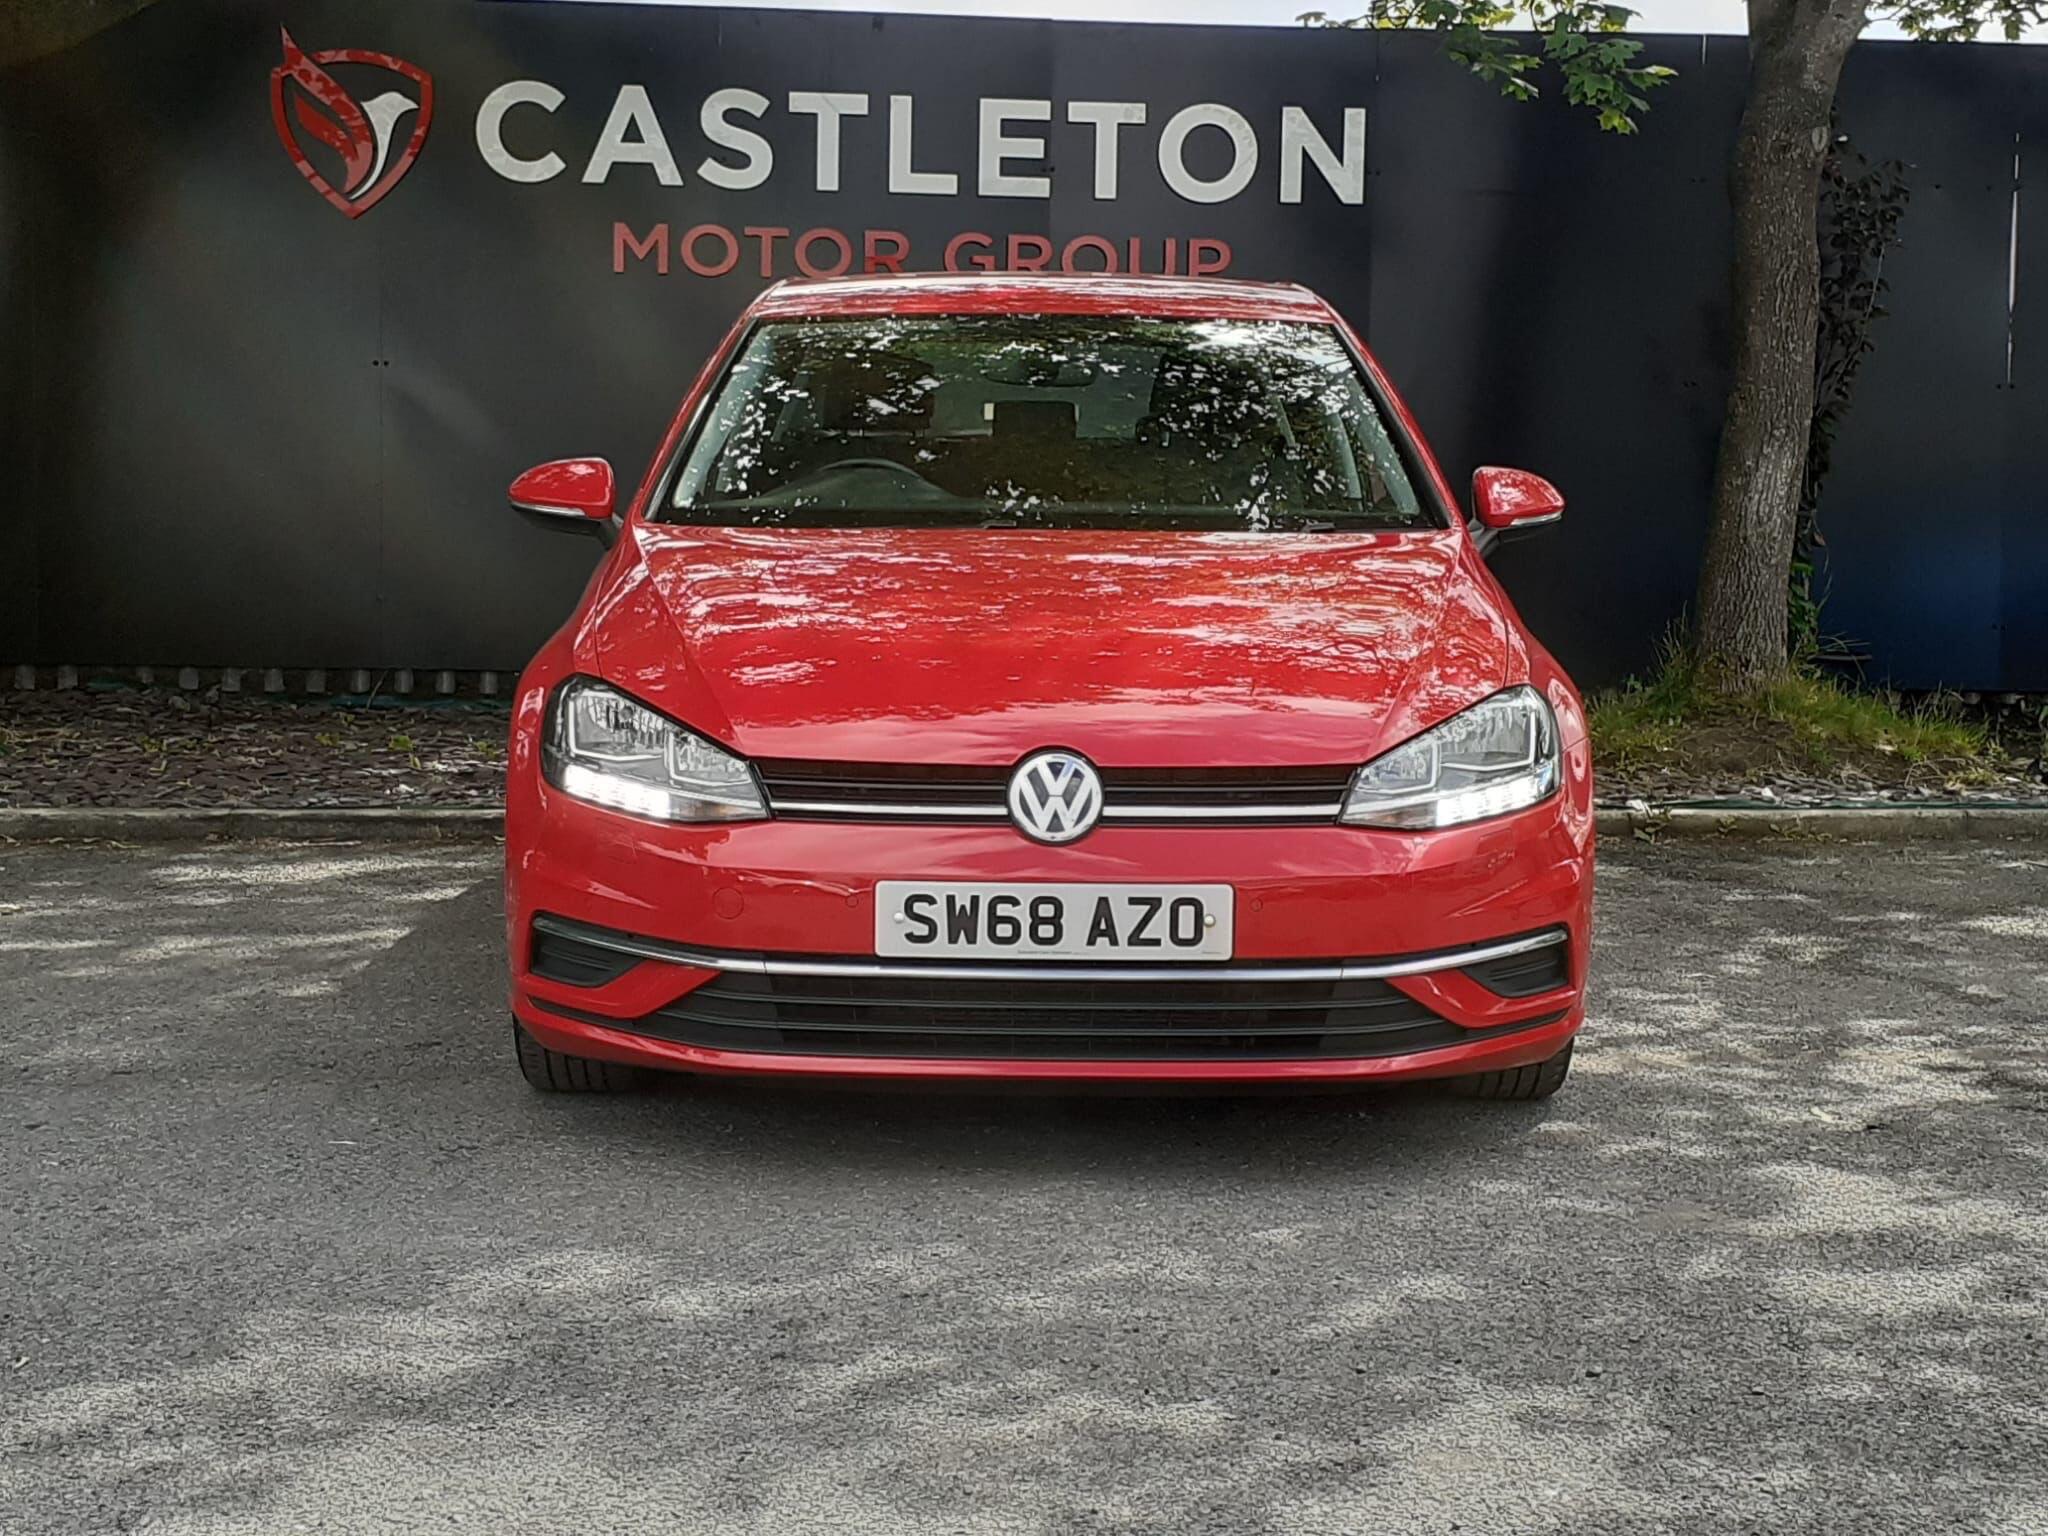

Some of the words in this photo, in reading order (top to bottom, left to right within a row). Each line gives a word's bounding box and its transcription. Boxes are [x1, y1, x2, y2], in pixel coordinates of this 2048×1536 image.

[475, 79, 1367, 205] CASTLETON
[612, 221, 911, 279] MOTOR
[943, 231, 1232, 278] GROUP
[1010, 752, 1103, 842] VW
[903, 893, 1064, 946] SW68
[1086, 896, 1206, 948] AZO
